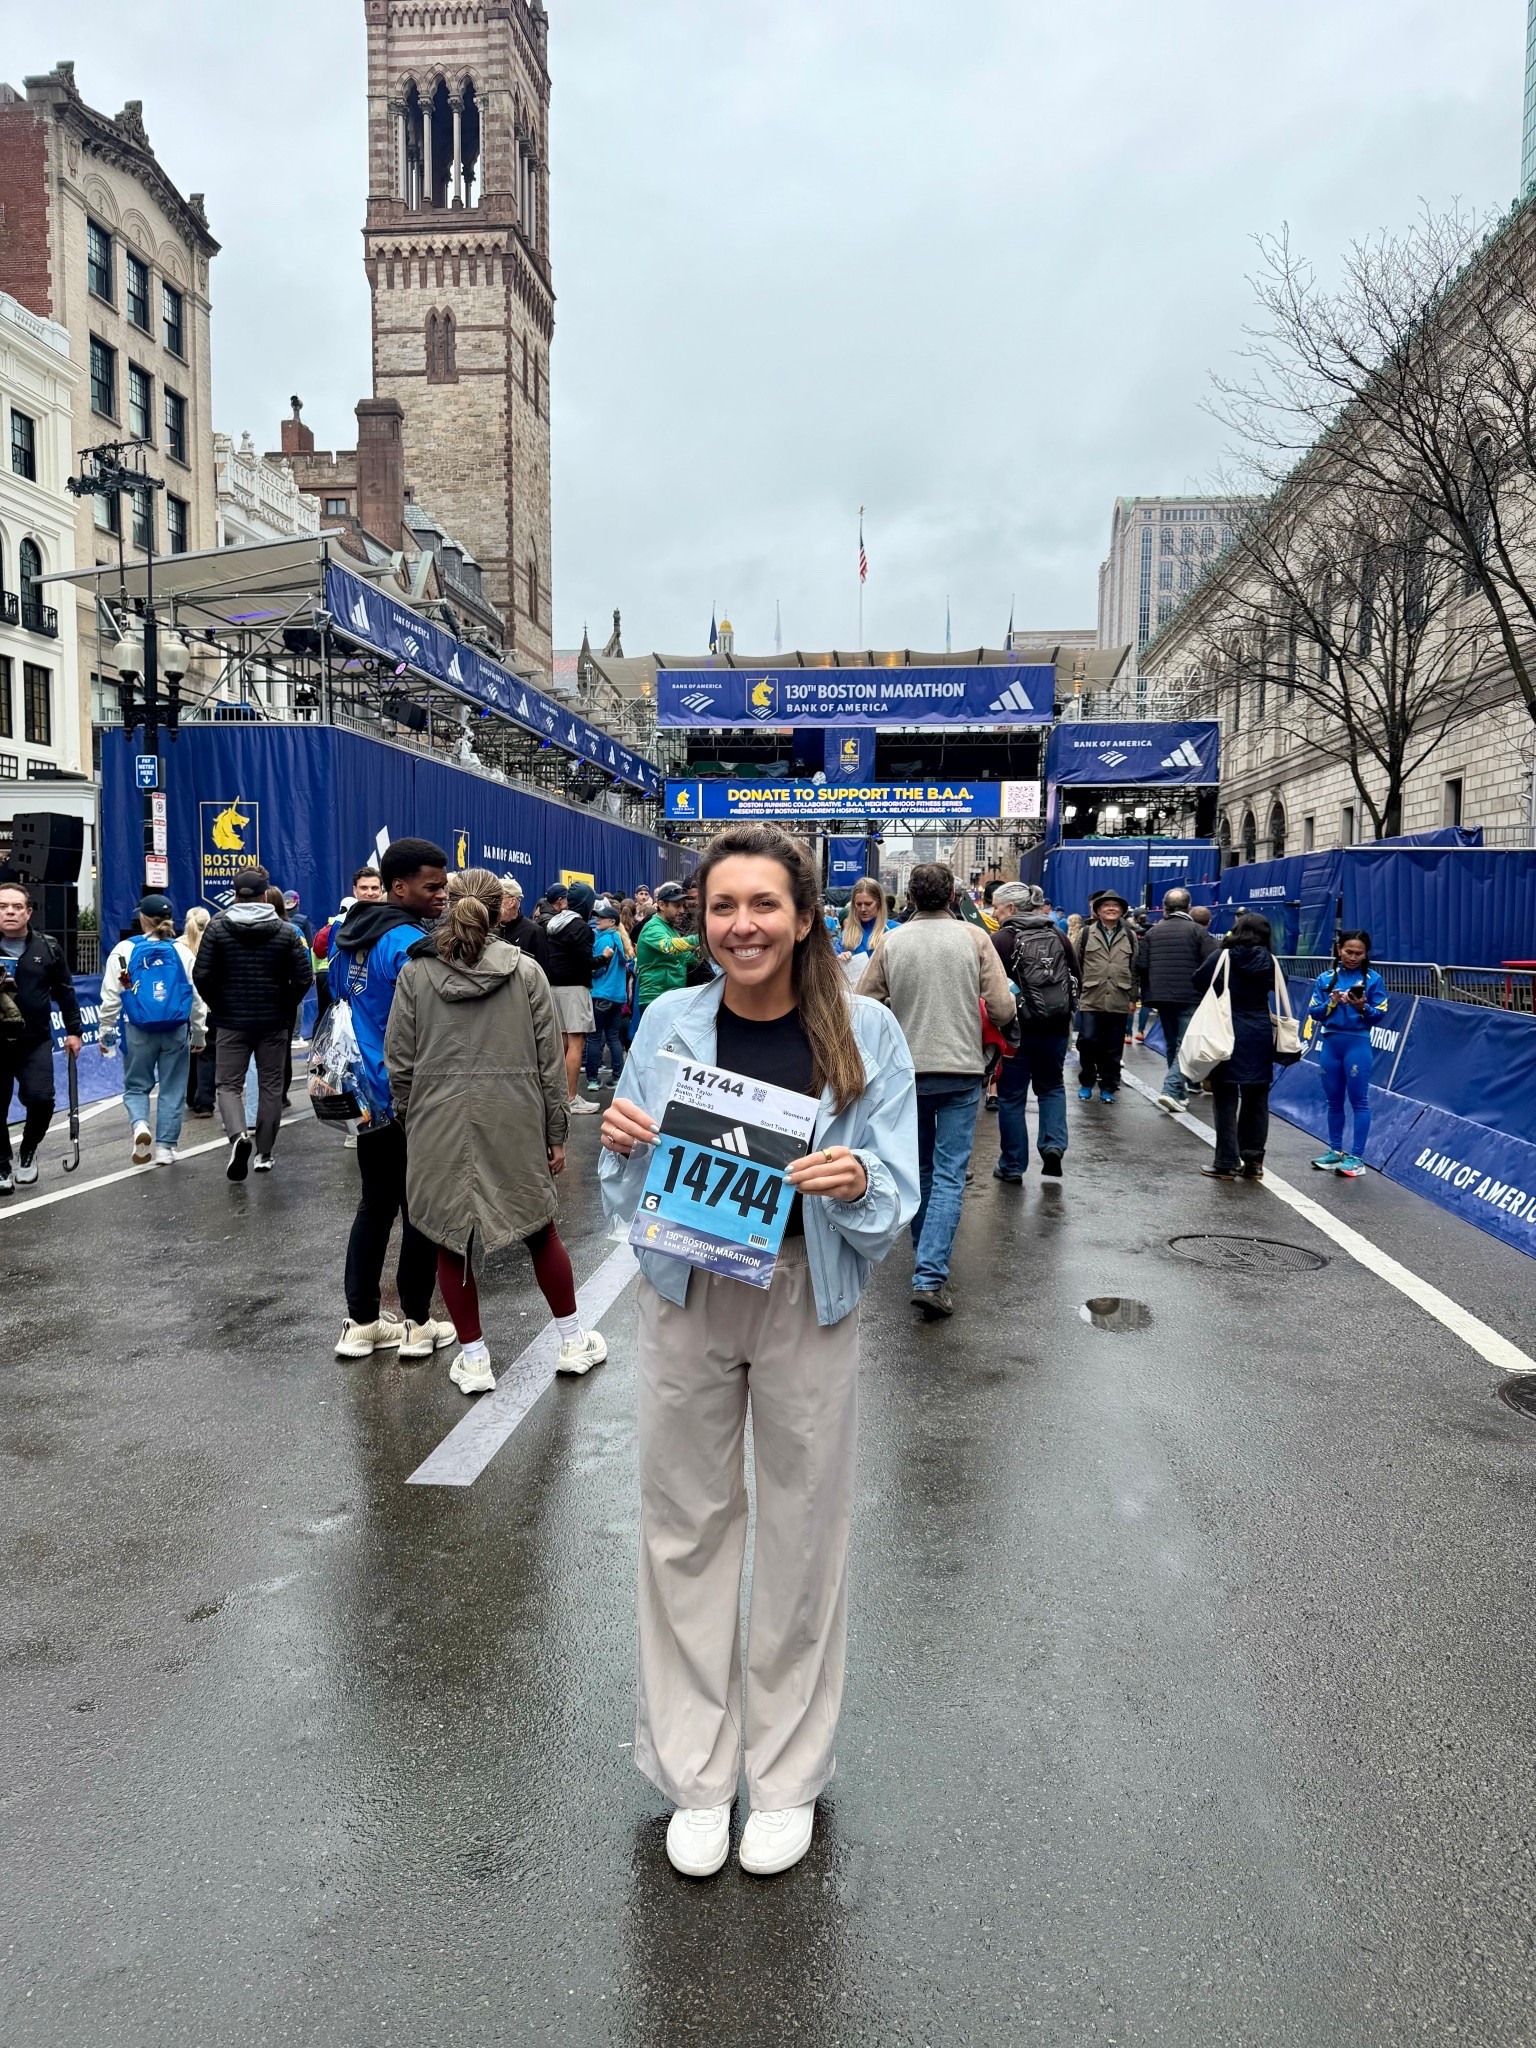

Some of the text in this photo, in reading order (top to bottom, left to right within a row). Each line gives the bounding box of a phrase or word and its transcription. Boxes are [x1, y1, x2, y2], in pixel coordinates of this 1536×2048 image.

[785, 683, 965, 699] 130TH BOSTON MARATHON
[787, 703, 888, 712] BANK OF AMERICA
[728, 787, 974, 801] DONATE TO SUPPORT THE B.A.A.
[204, 854, 256, 866] BOSTON
[1089, 856, 1119, 867] WCVB
[1148, 856, 1189, 867] ESPN
[204, 868, 240, 876] MARAT
[81, 1031, 93, 1043] OF
[682, 1066, 744, 1097] 14744
[760, 1120, 774, 1128] Start
[663, 1145, 784, 1226] 14744
[1415, 1147, 1536, 1225] BANK OF AMERIC
[645, 1195, 658, 1209] 6
[663, 1241, 680, 1250] BANK
[690, 1249, 718, 1262] AMERICA
[683, 1235, 715, 1254] BOSTON
[716, 1246, 761, 1268] MARATHON
